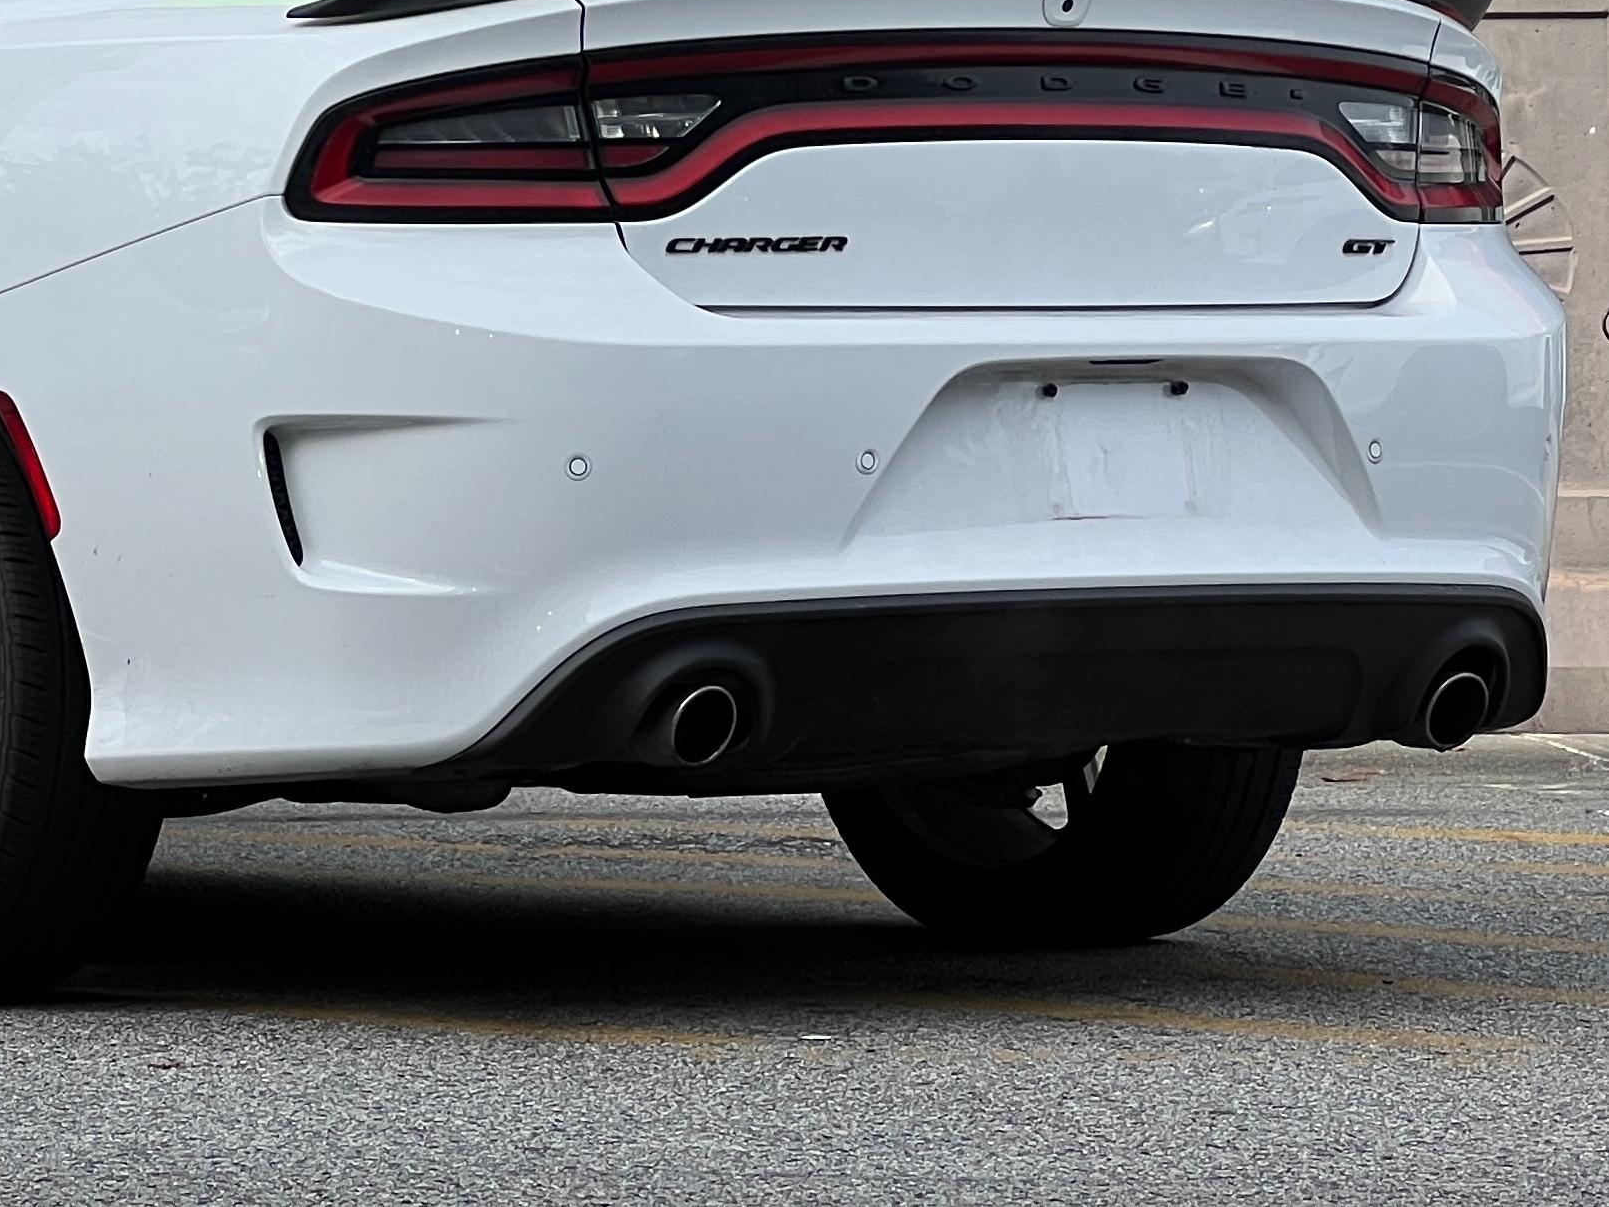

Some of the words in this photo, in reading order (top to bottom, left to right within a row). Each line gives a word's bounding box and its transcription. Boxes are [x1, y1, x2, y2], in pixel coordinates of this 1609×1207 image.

[841, 74, 1248, 100] DODGE
[665, 235, 849, 255] CHARGER
[1342, 238, 1395, 255] GT
